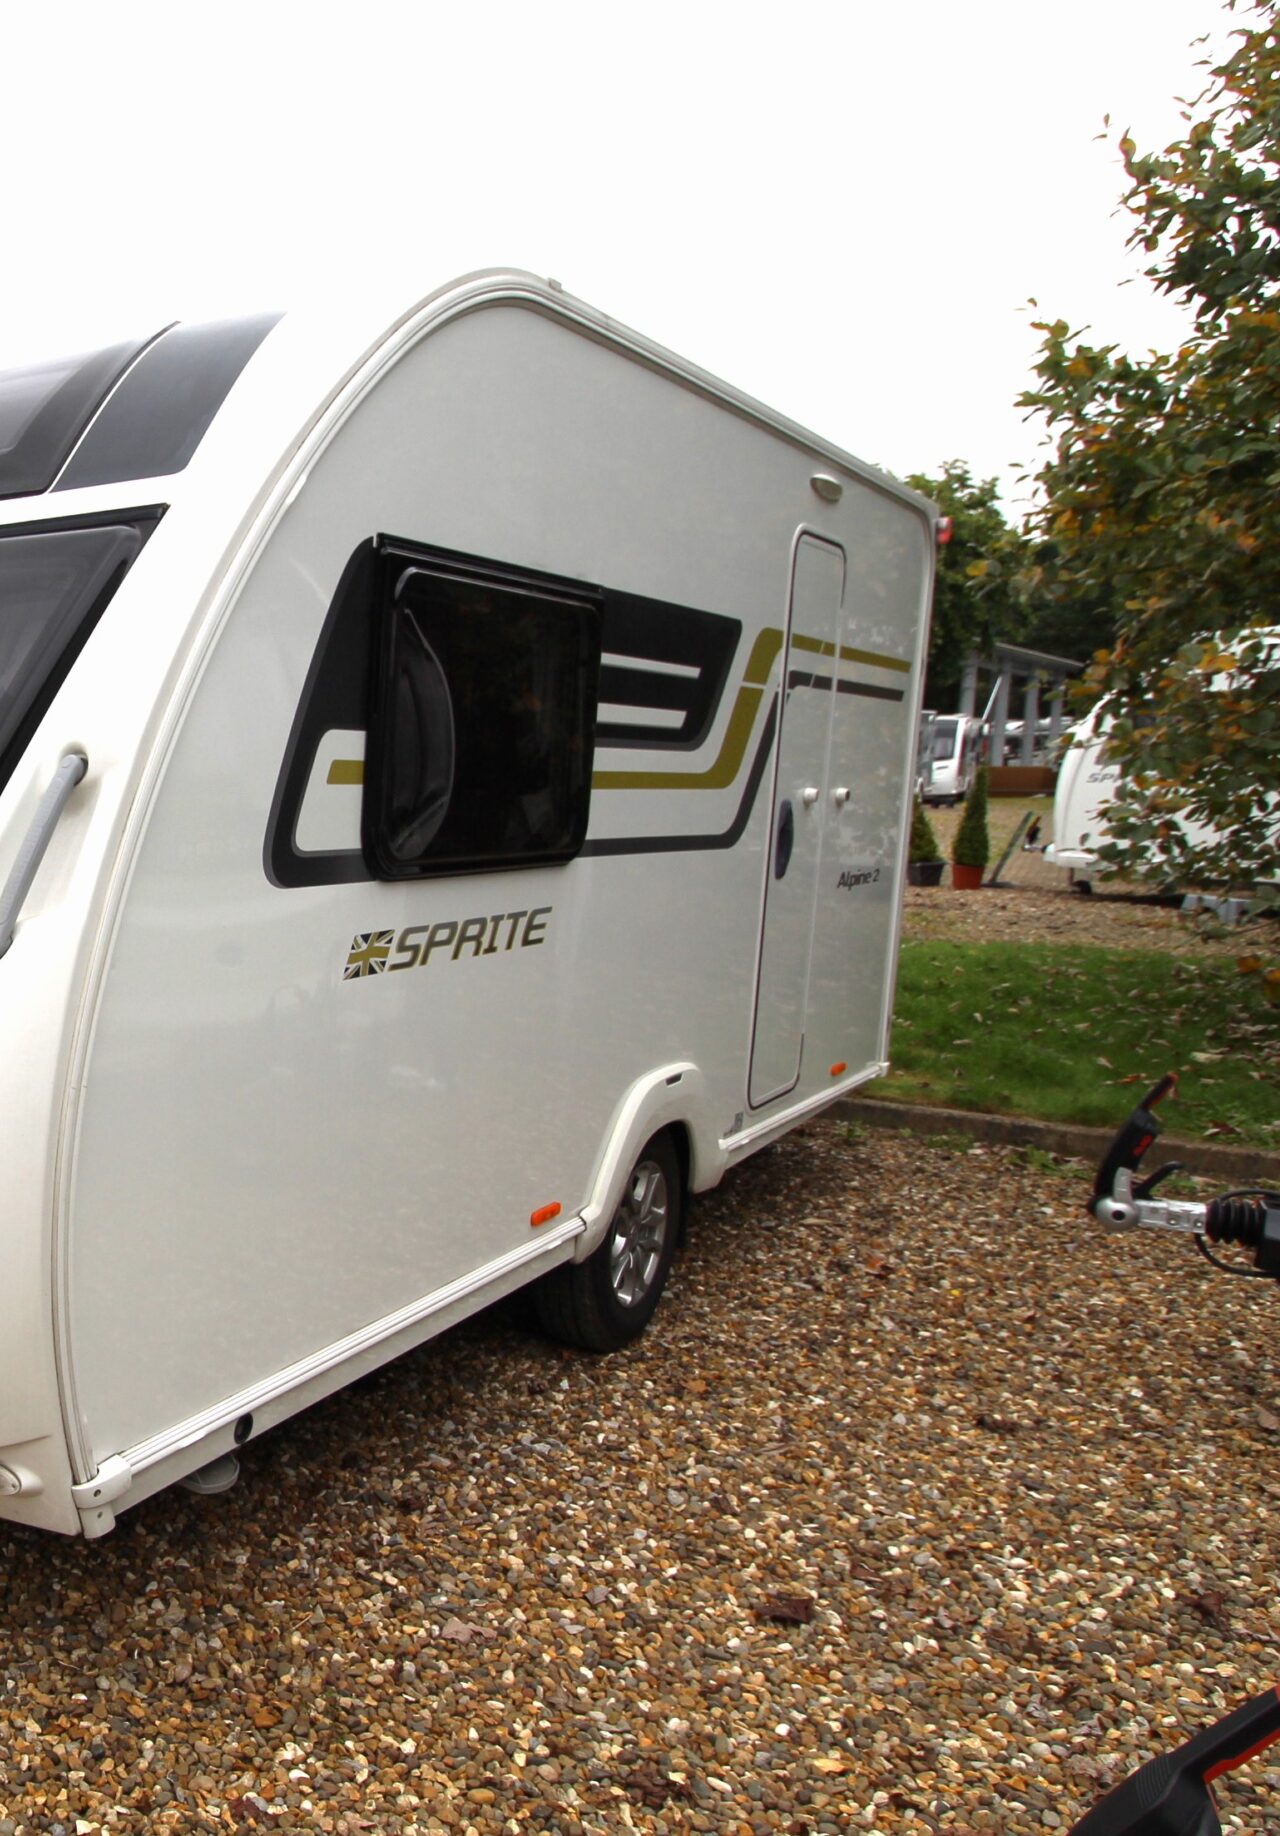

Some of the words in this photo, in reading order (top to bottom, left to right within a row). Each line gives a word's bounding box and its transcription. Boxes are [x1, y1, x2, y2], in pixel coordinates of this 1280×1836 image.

[836, 869, 872, 892] Alpine
[872, 868, 880, 882] 2
[387, 906, 553, 972] SPRITE
